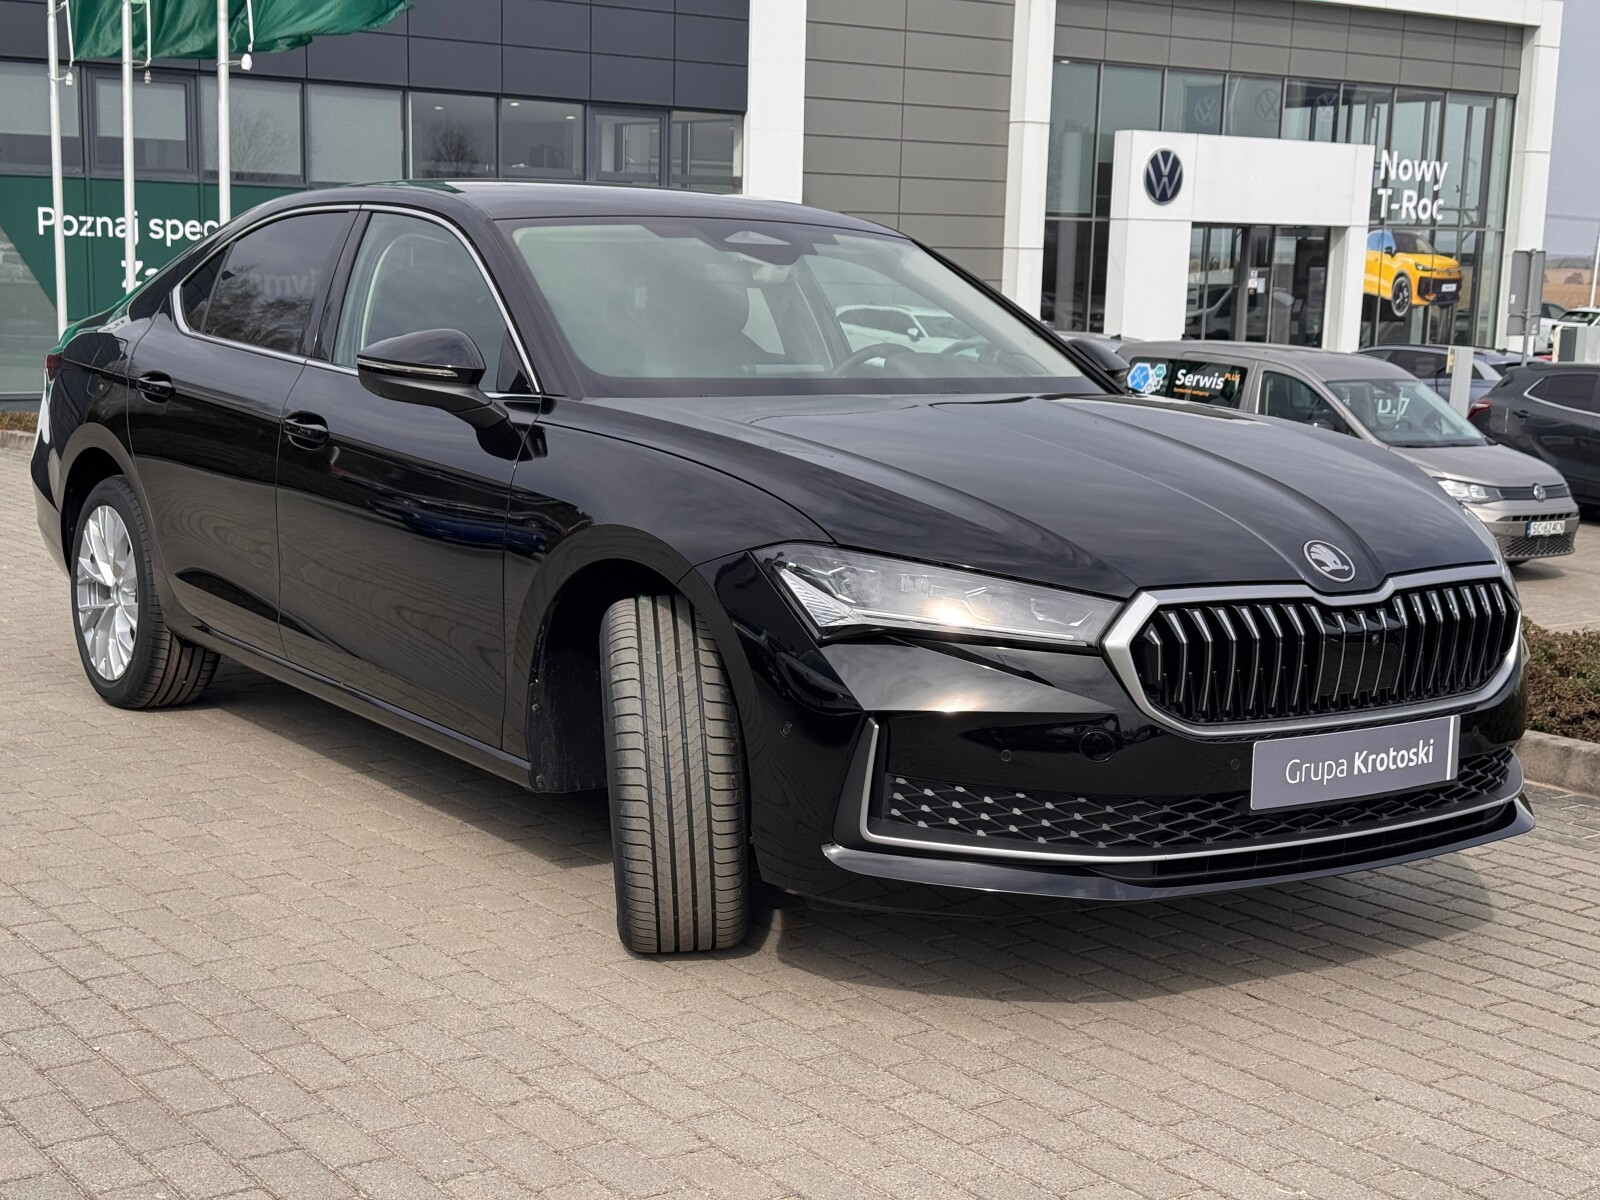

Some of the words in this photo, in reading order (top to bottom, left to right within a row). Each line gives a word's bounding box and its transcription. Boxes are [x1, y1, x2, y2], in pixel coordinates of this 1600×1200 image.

[1379, 149, 1449, 191] Nowy
[1377, 188, 1444, 221] T-Roc
[1175, 368, 1225, 390] Serwis
[1224, 372, 1241, 382] PLUS
[1286, 758, 1347, 786] Grupa
[1353, 738, 1434, 776] Krotoski
